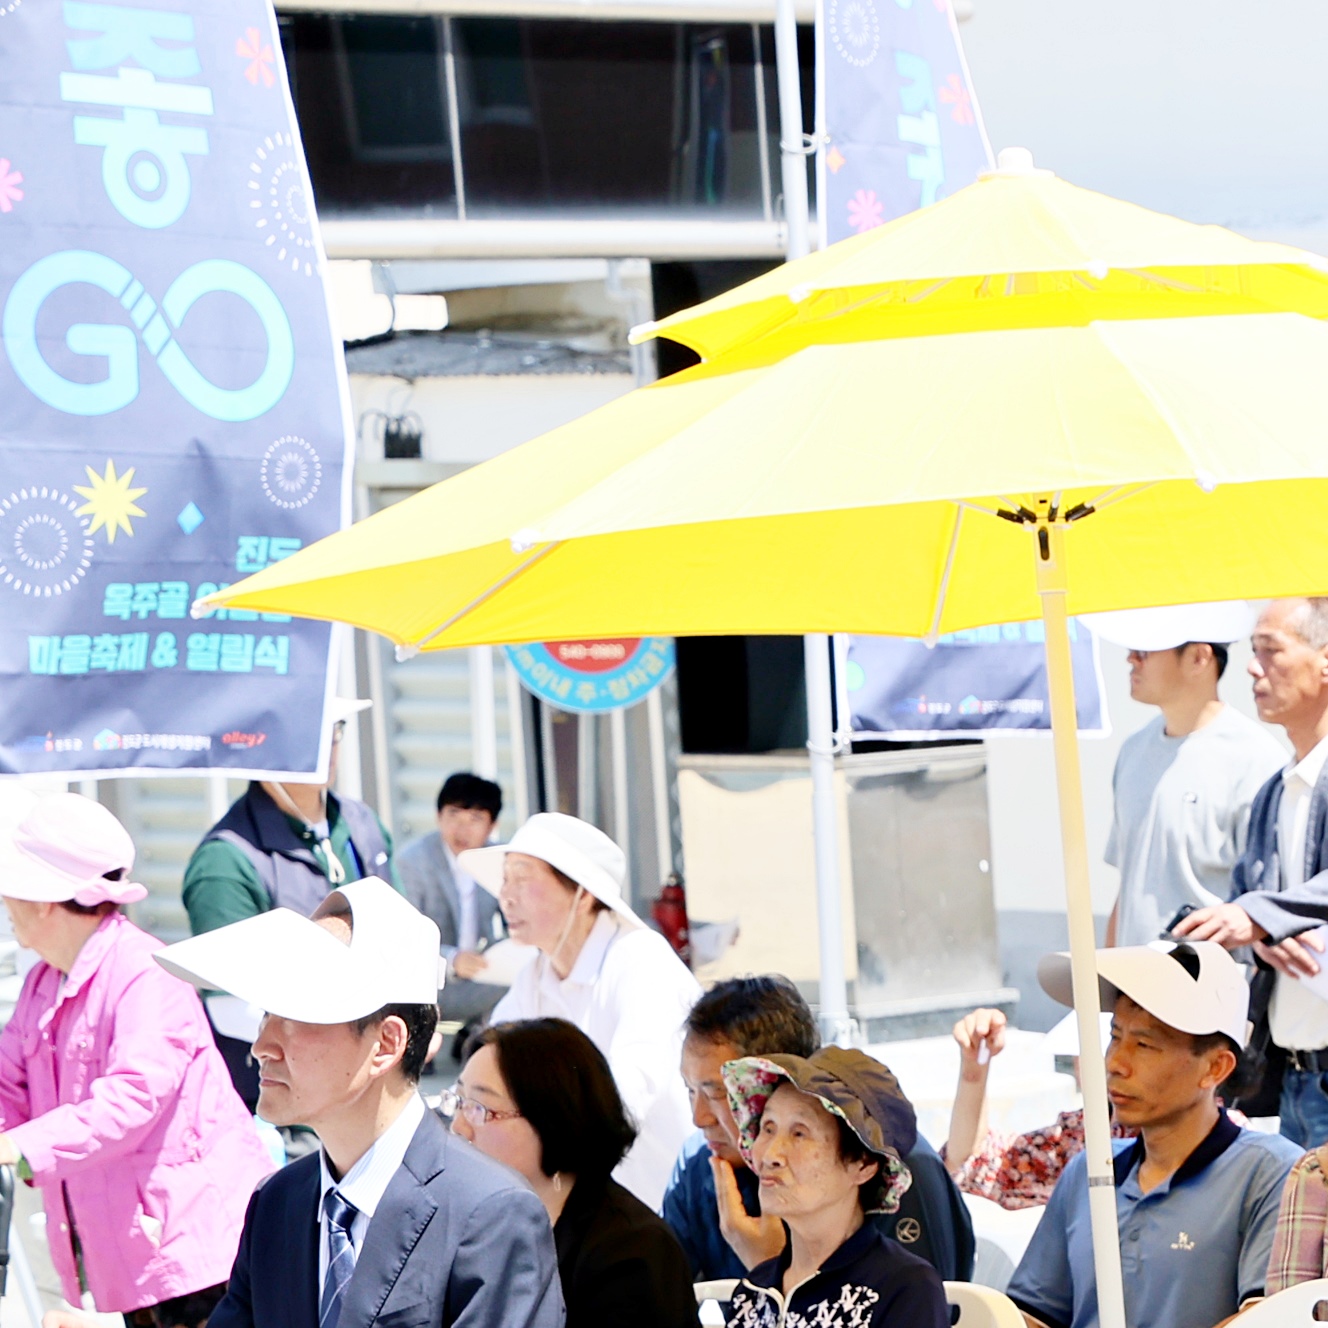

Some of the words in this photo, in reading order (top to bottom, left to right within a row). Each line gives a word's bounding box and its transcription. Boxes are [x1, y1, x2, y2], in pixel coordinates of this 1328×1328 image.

[3, 249, 294, 422] GO
[28, 632, 150, 675] 마을축제
[151, 631, 178, 668] &
